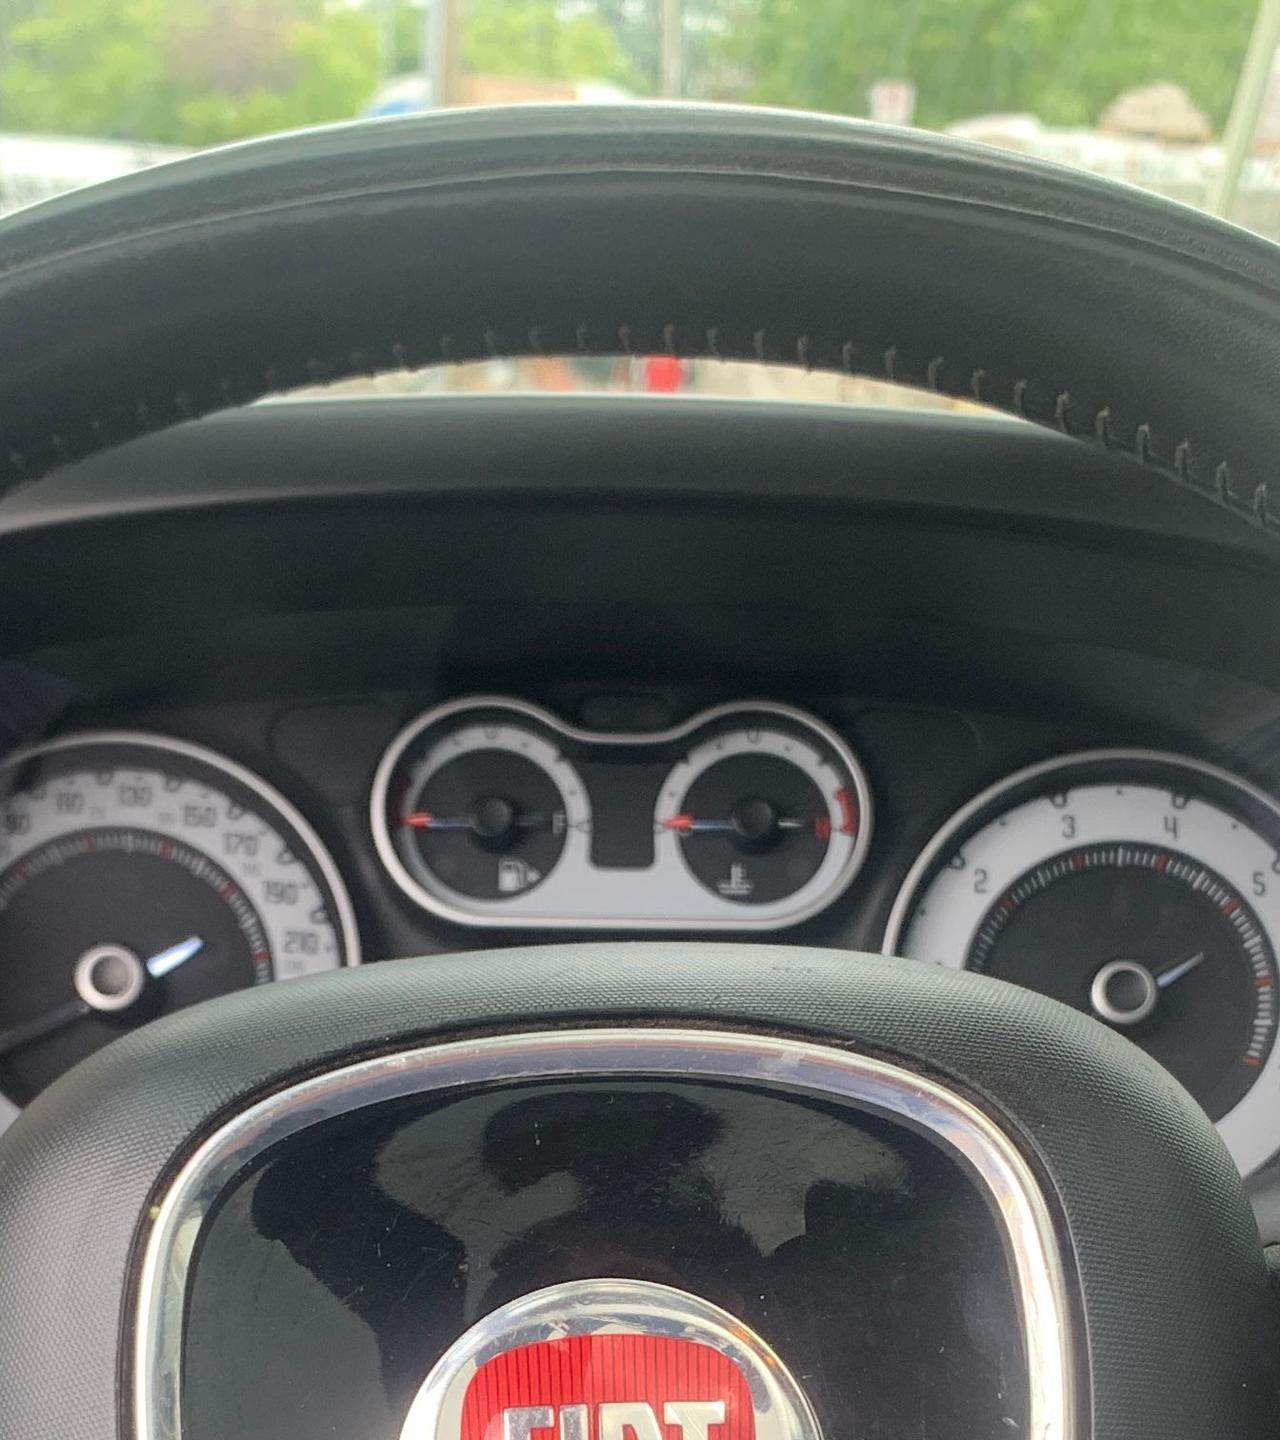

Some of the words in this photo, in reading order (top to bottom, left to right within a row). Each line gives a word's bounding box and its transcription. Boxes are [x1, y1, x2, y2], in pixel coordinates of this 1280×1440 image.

[183, 803, 217, 828] 150
[1062, 815, 1076, 839] 3
[1163, 815, 1180, 840] 4
[222, 831, 258, 856] 170
[263, 880, 298, 905] 190
[973, 867, 988, 894] 2
[1252, 872, 1267, 897] 5
